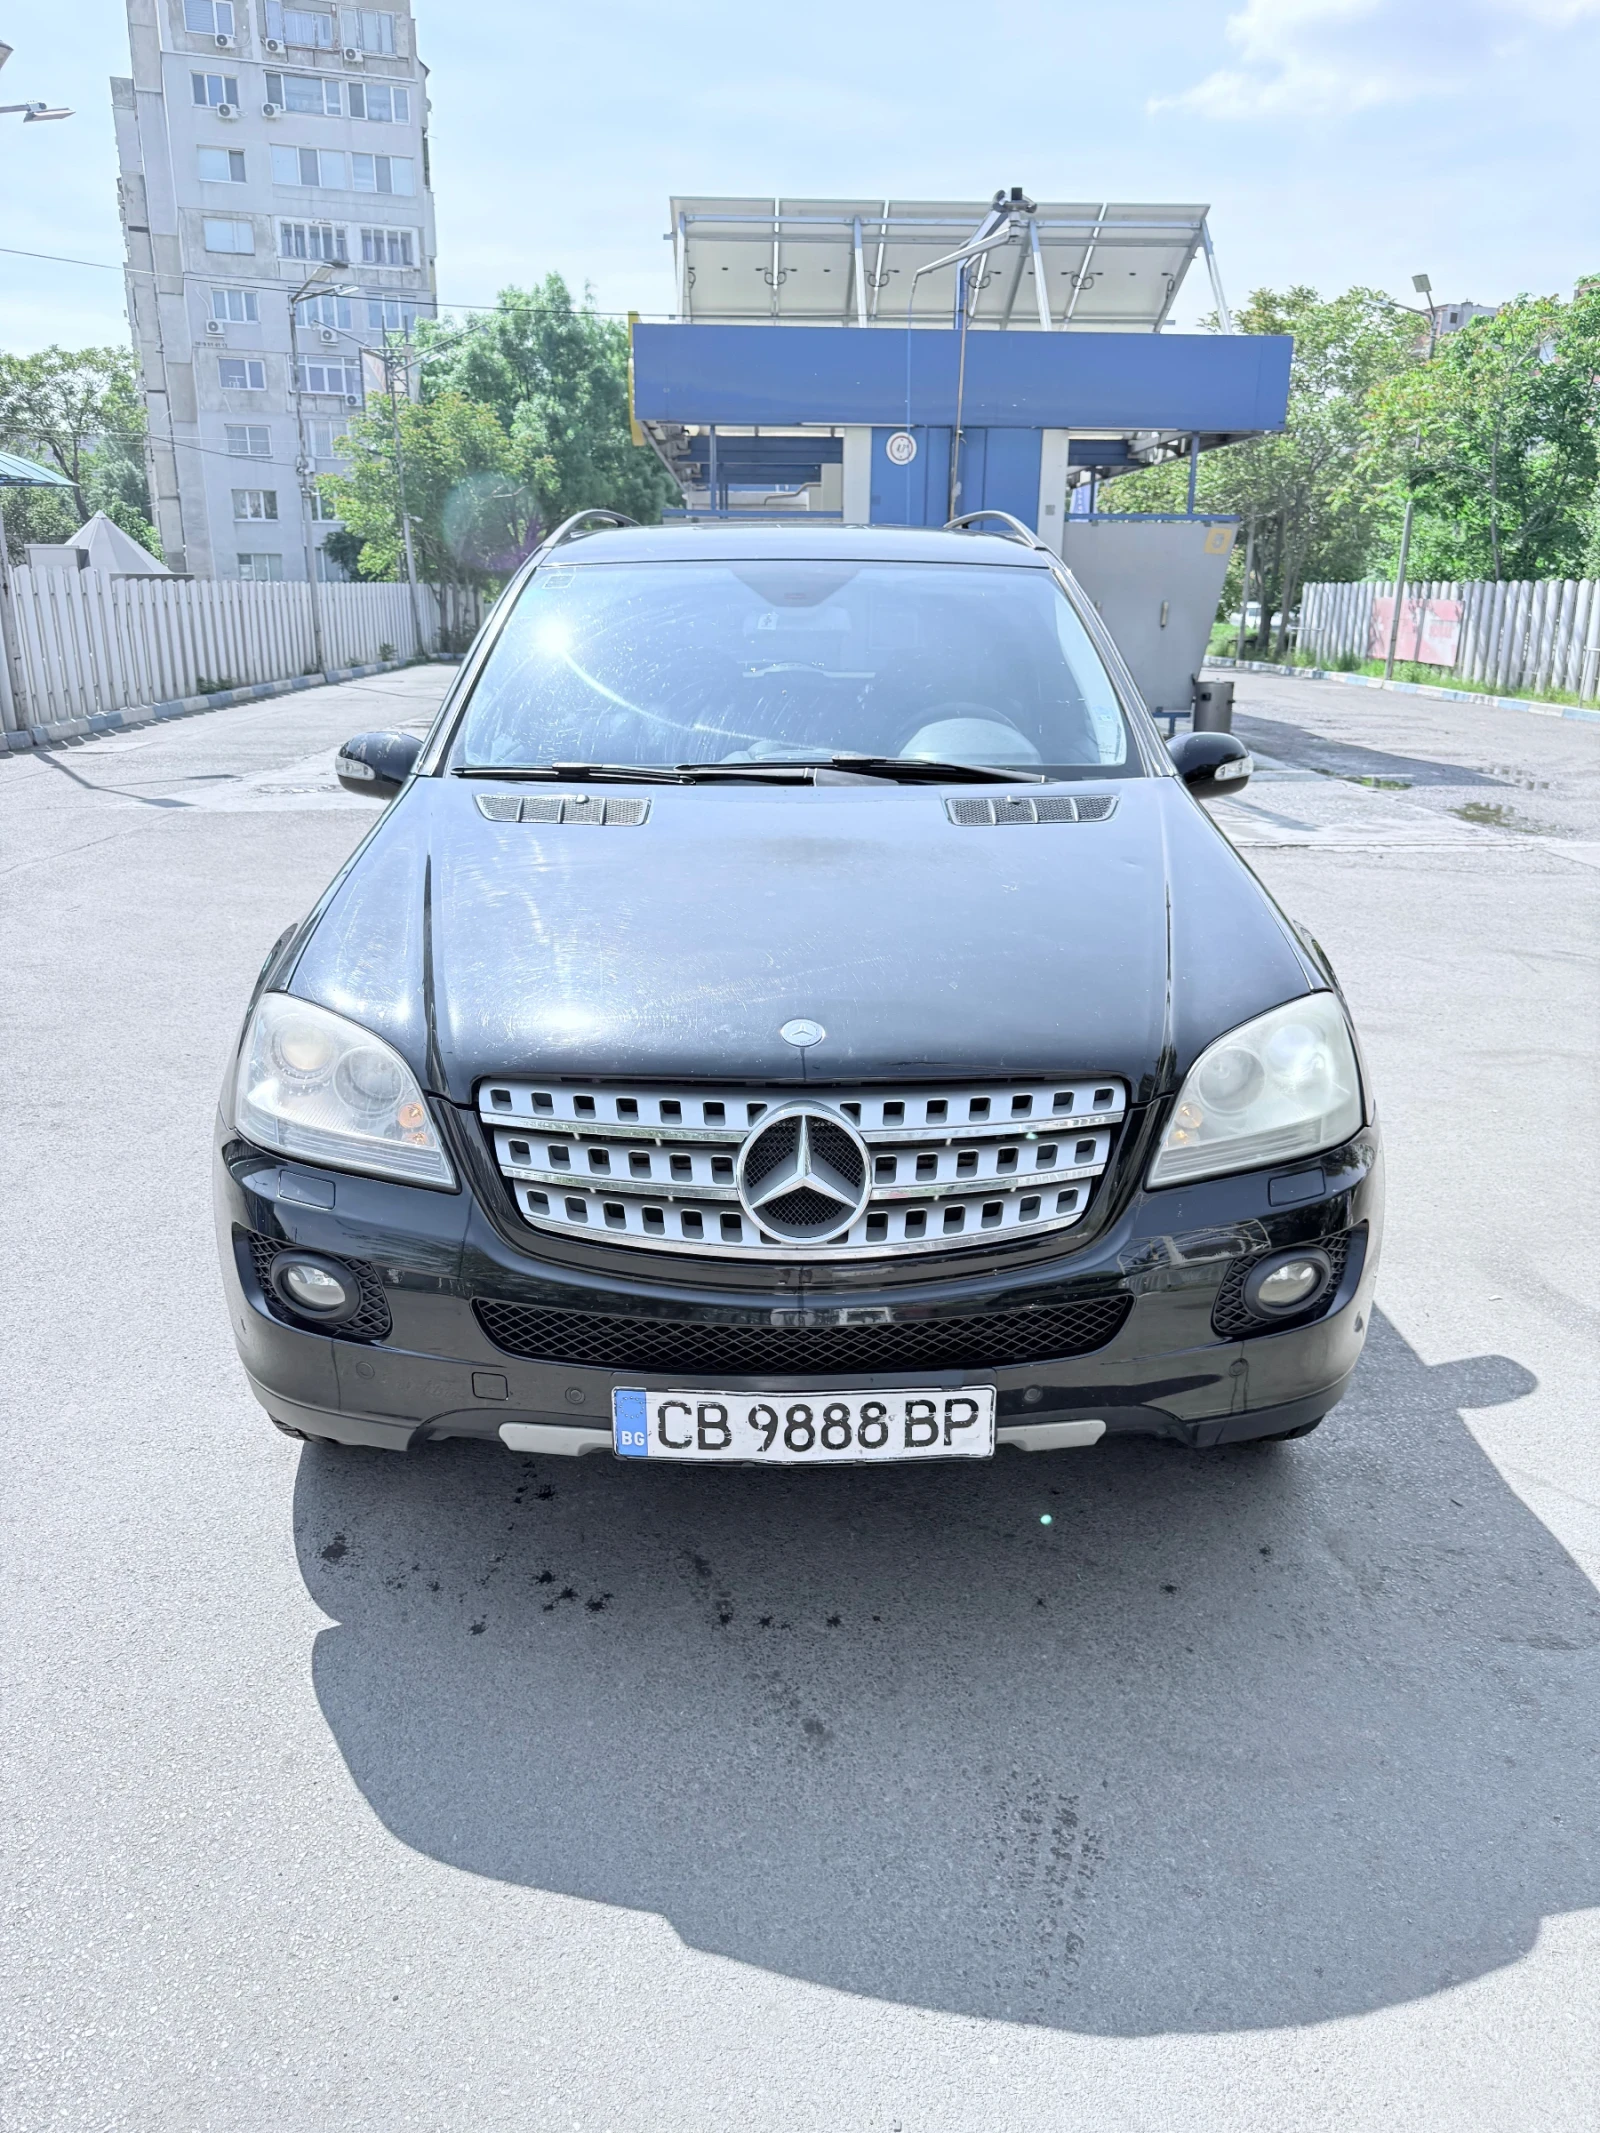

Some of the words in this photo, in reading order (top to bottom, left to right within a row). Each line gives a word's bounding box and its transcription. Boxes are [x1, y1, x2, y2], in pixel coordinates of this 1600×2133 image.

[621, 1430, 645, 1446] BG
[657, 1399, 732, 1450] CB
[747, 1401, 890, 1452] 9888
[903, 1398, 979, 1449] BP
